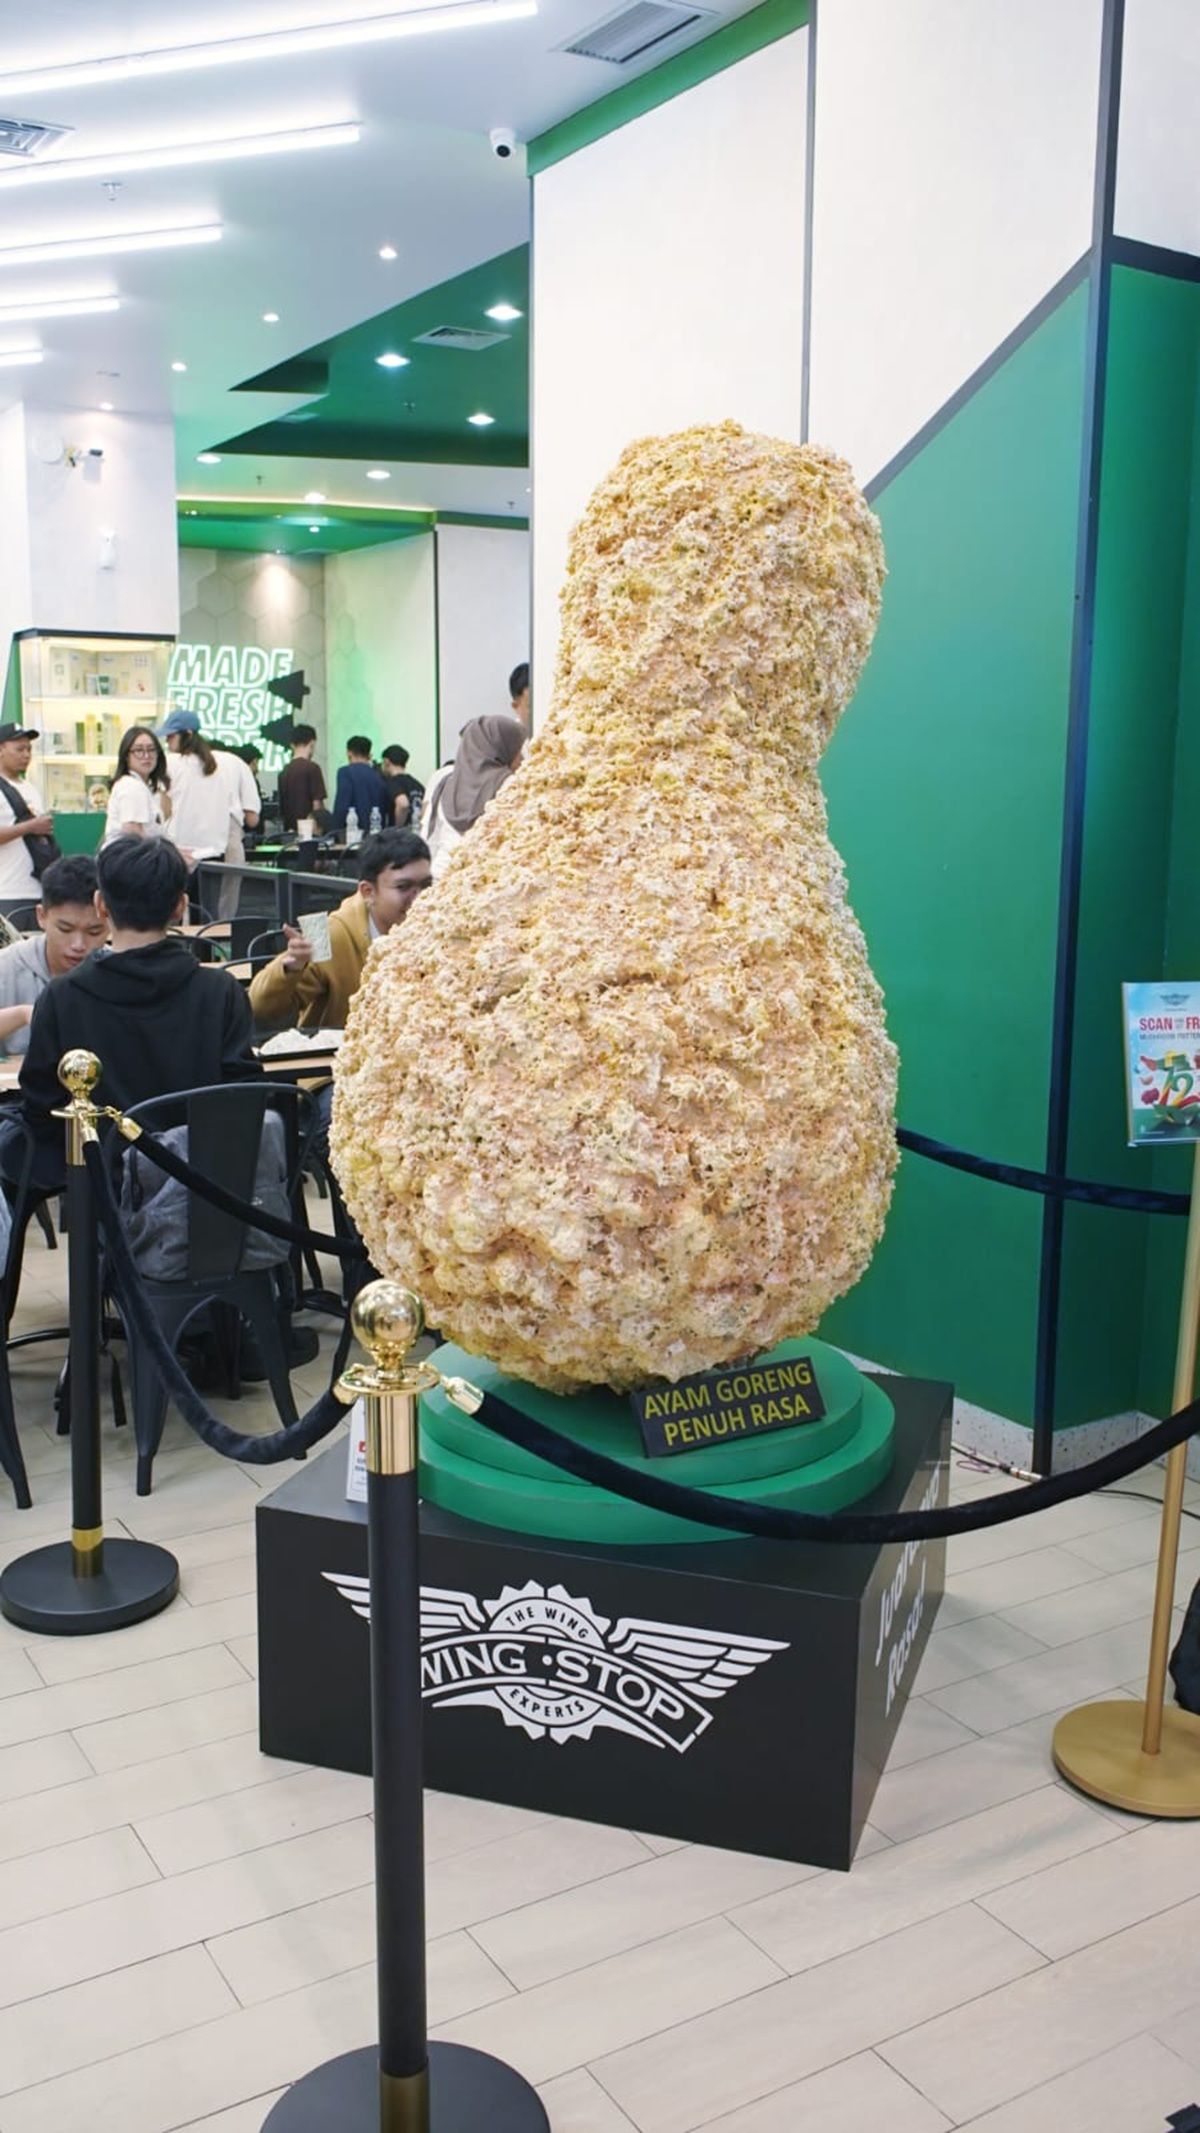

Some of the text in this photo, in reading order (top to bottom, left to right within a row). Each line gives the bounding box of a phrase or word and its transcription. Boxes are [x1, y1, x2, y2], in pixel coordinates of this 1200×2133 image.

[167, 644, 294, 688] MADE
[1139, 1017, 1173, 1031] SCAN
[644, 1363, 812, 1419] AYAM GORENG
[664, 1394, 811, 1446] PENUH RASA
[506, 1606, 589, 1639] THE WING
[509, 1688, 585, 1718] EXPERTS
[555, 1649, 685, 1722] STOP
